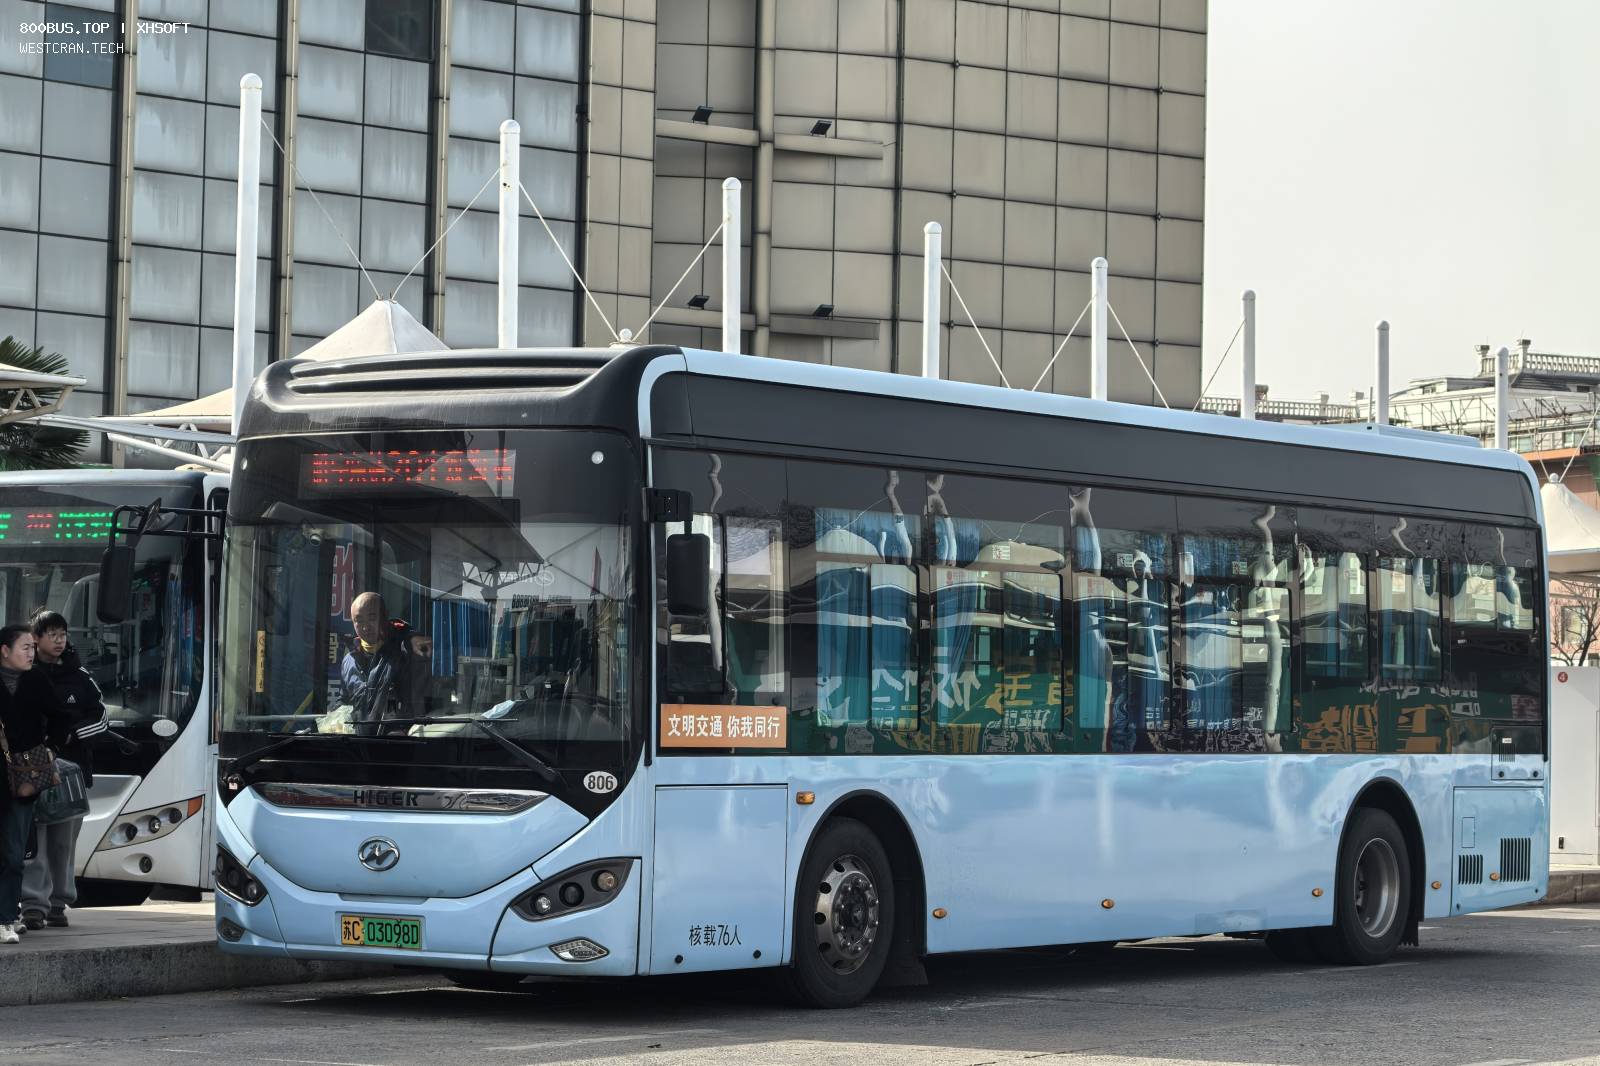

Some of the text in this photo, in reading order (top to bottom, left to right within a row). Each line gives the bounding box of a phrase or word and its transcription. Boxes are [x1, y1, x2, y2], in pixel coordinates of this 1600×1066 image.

[667, 713, 780, 738] 文明交通 你我同行
[588, 774, 614, 790] 806
[353, 789, 418, 807] HIGER
[688, 924, 742, 947] 核载76人
